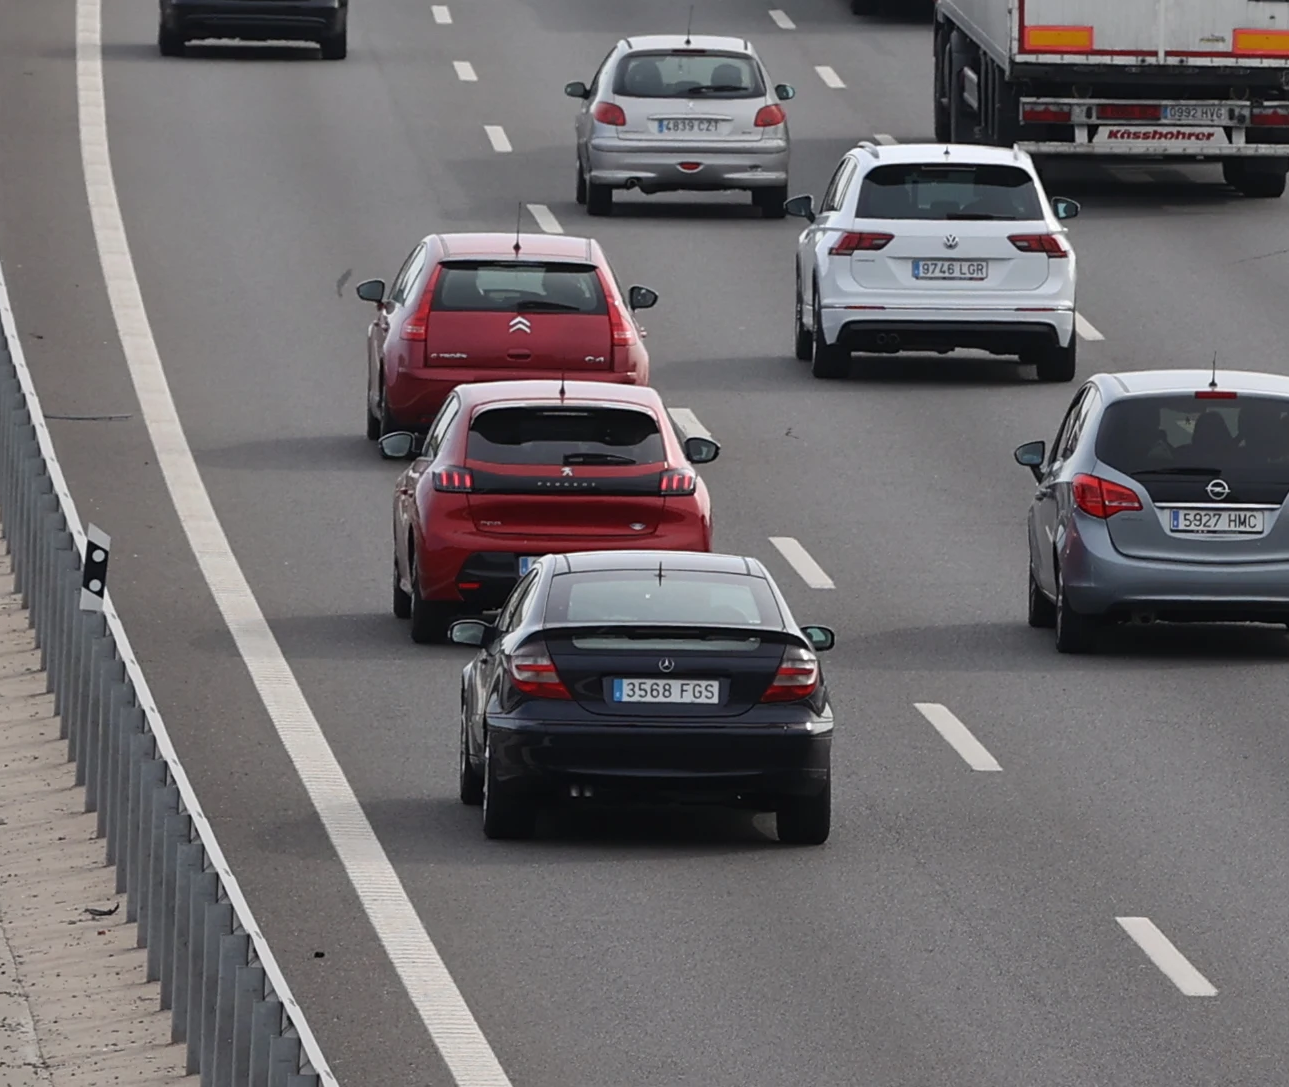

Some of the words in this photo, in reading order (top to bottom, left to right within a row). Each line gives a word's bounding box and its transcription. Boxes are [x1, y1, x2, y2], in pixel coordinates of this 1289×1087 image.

[1171, 108, 1198, 118] 0992
[1201, 108, 1223, 118] HVG
[1107, 129, 1215, 141] Kässbohrer
[922, 263, 956, 275] 9746
[959, 263, 984, 276] LGR
[1183, 513, 1222, 528] 5927
[1227, 514, 1257, 528] HMC
[626, 682, 673, 699] 3568
[680, 683, 715, 700] FGS
